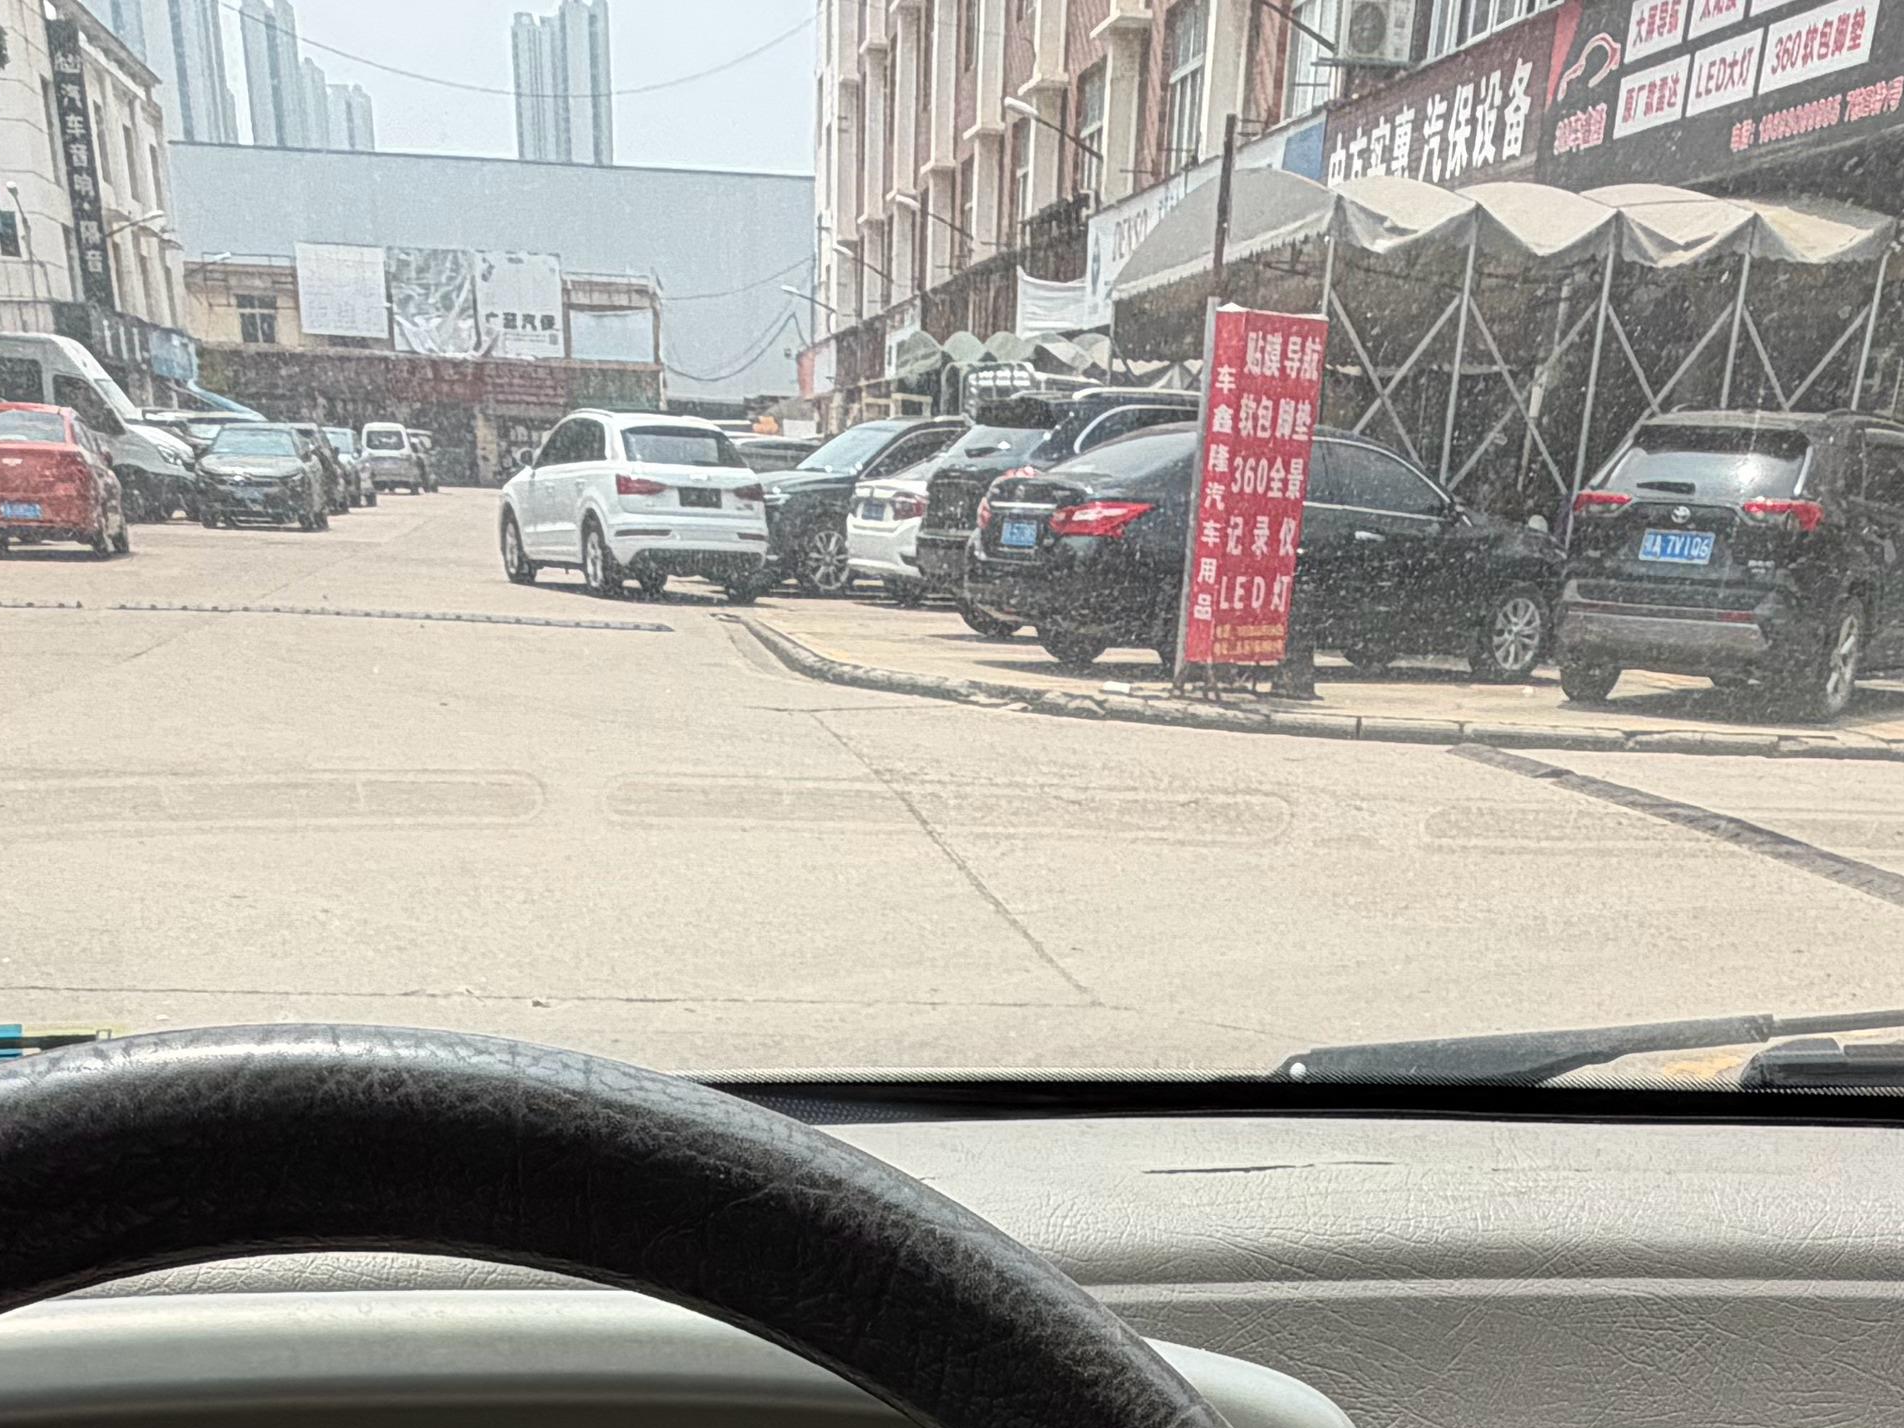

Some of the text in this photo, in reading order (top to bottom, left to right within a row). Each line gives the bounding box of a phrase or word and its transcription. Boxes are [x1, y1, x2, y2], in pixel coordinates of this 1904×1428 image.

[1695, 47, 1755, 99] LED大灯
[1418, 58, 1533, 183] 汽保设备
